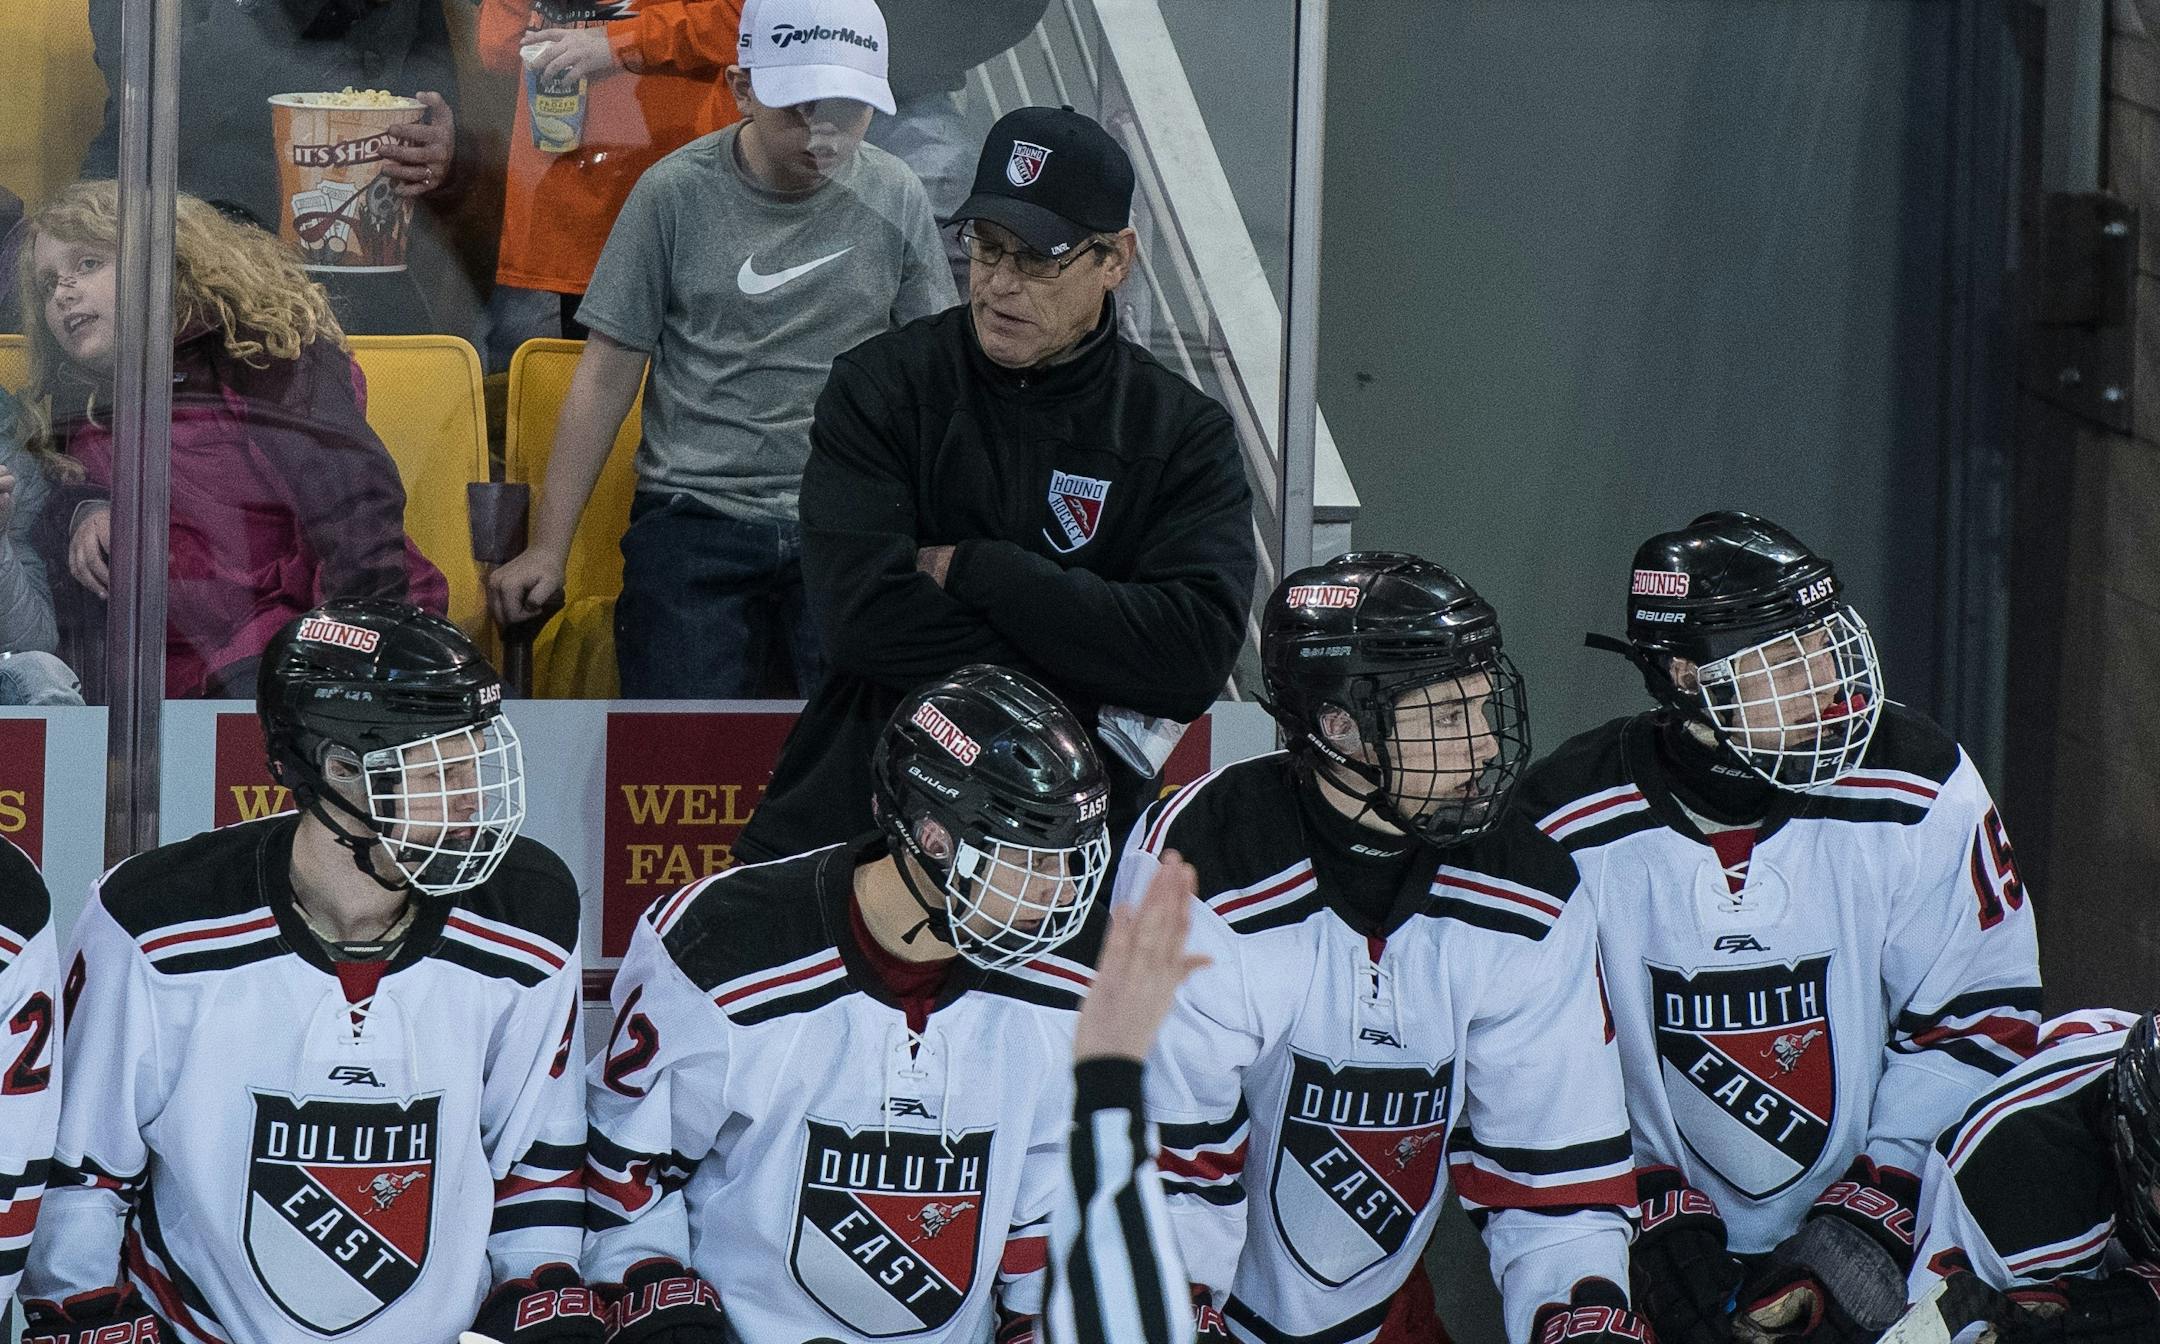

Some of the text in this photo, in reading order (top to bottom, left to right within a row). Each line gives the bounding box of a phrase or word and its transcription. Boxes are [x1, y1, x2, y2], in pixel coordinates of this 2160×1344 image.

[771, 24, 879, 52] TaylorMade
[295, 144, 330, 164] IT'S
[1053, 475, 1104, 499] HOUND
[1051, 497, 1083, 542] HOCKEY
[1286, 586, 1360, 609] HOUNDS
[1632, 570, 1690, 598] HOUNDS
[1798, 577, 1833, 606] EAST
[298, 618, 380, 654] HOUNDS
[1636, 609, 1686, 624] BAUER
[479, 683, 501, 705] EAST
[912, 702, 981, 767] HOUNDS
[621, 784, 768, 825] WEL
[1079, 795, 1107, 822] EAST
[1666, 981, 1818, 1029] DULUTH
[1301, 1083, 1447, 1126] DULUTH
[1688, 1051, 1808, 1142] EAST
[268, 1120, 428, 1161] DULUTH
[820, 1148, 980, 1192] DULUTH
[1310, 1146, 1402, 1235] EAST
[282, 1183, 397, 1280] EAST
[1814, 1181, 1914, 1246] BAU
[830, 1210, 942, 1304] EAST
[514, 1287, 606, 1331] BAU
[1543, 1305, 1660, 1344] BAU
